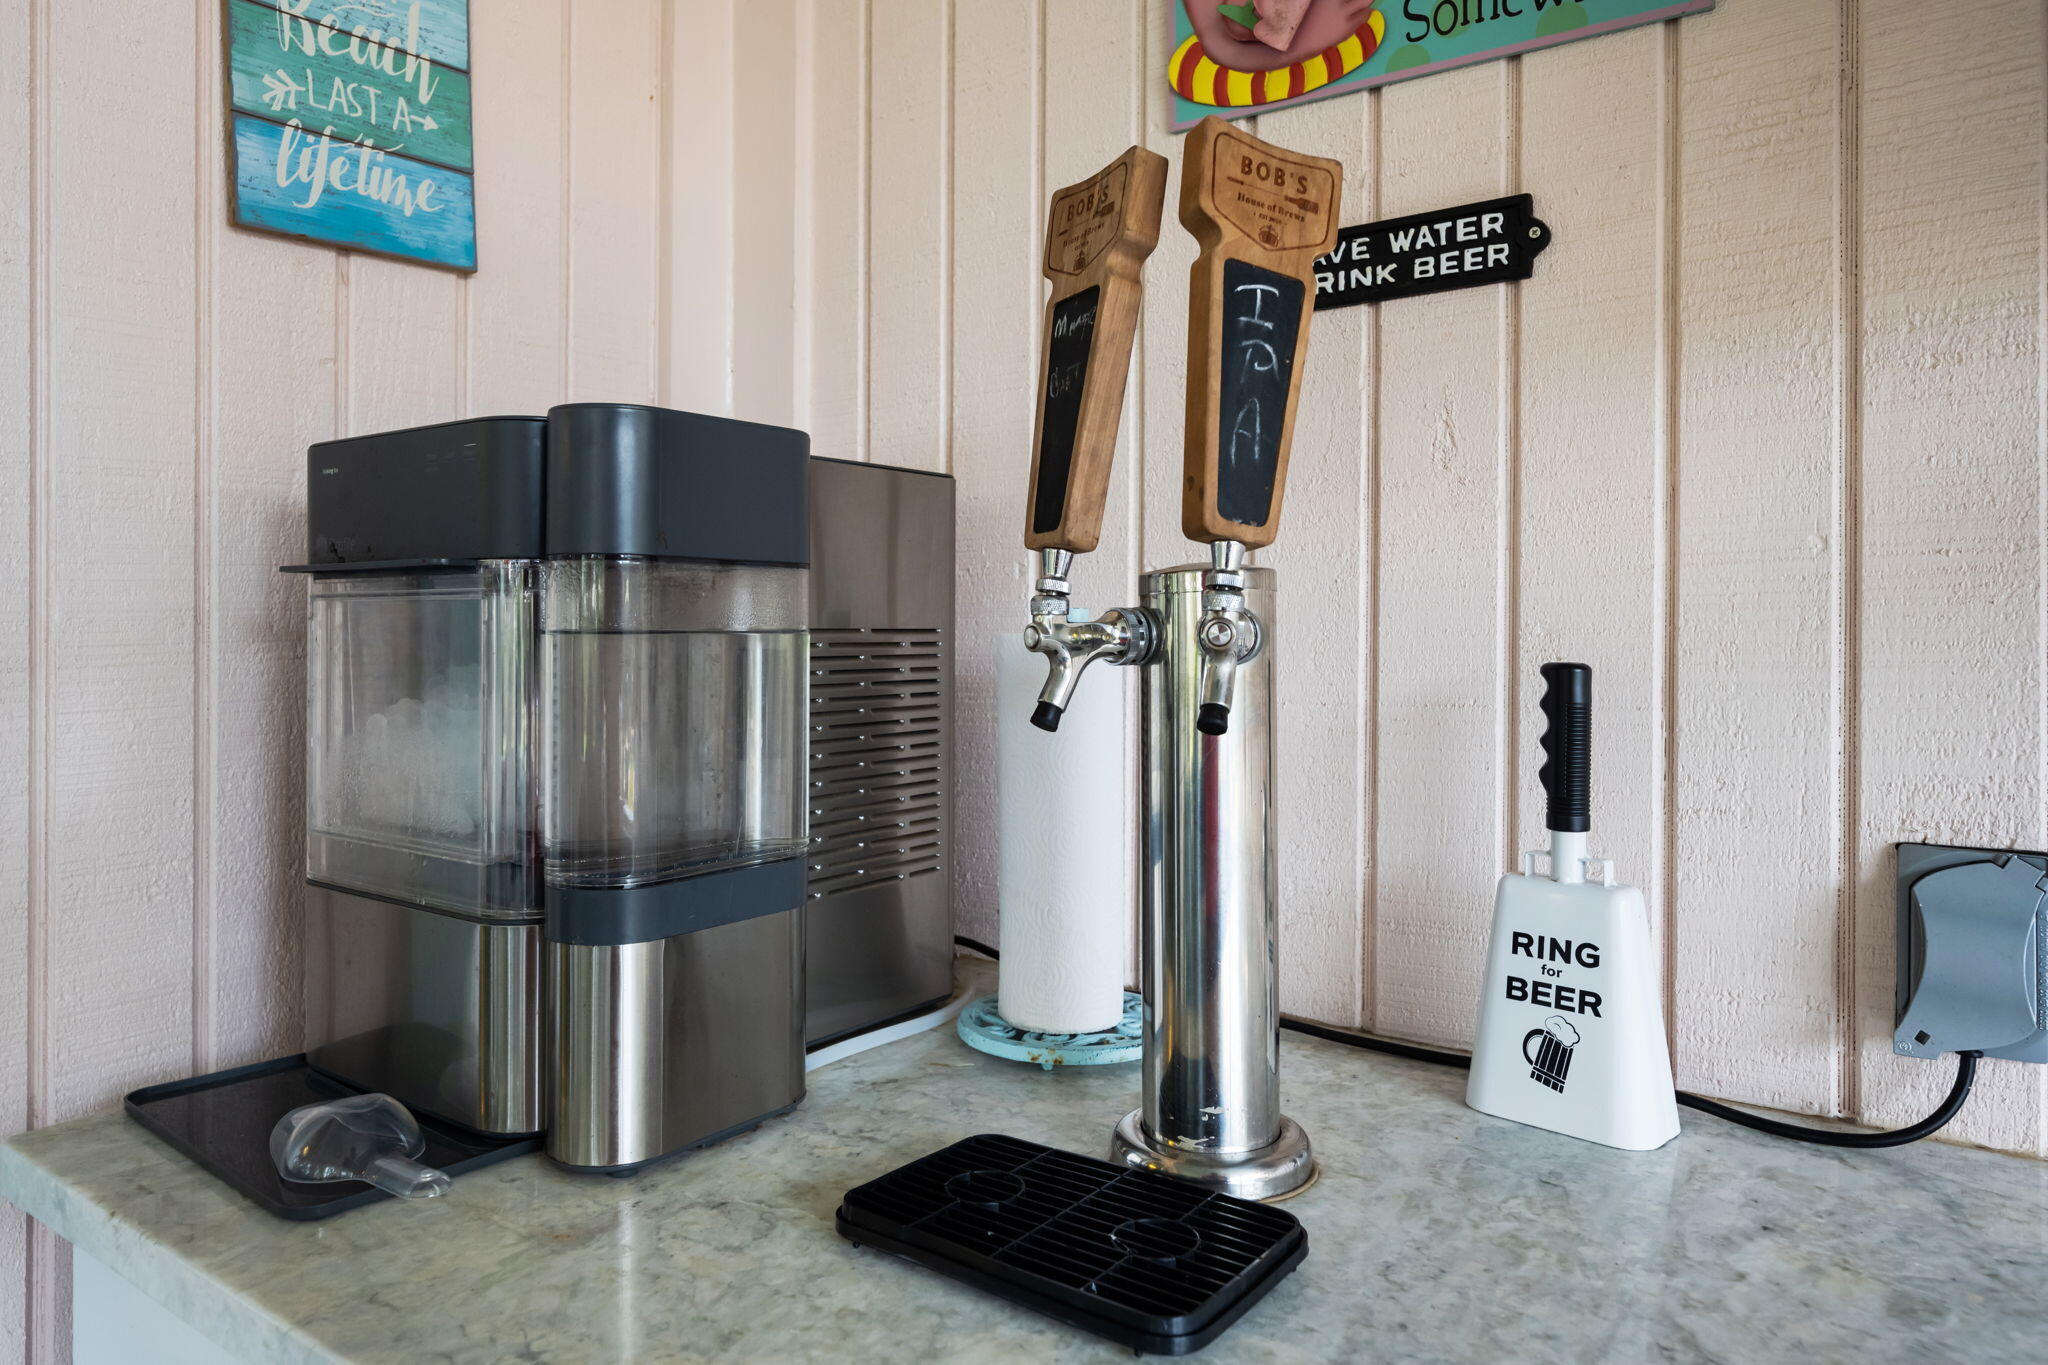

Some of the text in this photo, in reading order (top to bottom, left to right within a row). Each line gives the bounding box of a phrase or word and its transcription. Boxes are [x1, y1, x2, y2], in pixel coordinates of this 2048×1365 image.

[306, 68, 412, 133] LAST A
[276, 118, 444, 217] lifetime
[1240, 155, 1308, 195] BOB'S
[1067, 184, 1110, 223] BOB'S
[1267, 203, 1277, 213] of
[1312, 213, 1504, 266] VE WATER
[1314, 243, 1509, 295] RINK BEER
[1511, 931, 1600, 969] RING
[1541, 964, 1562, 978] for
[1505, 975, 1603, 1018] BEER
